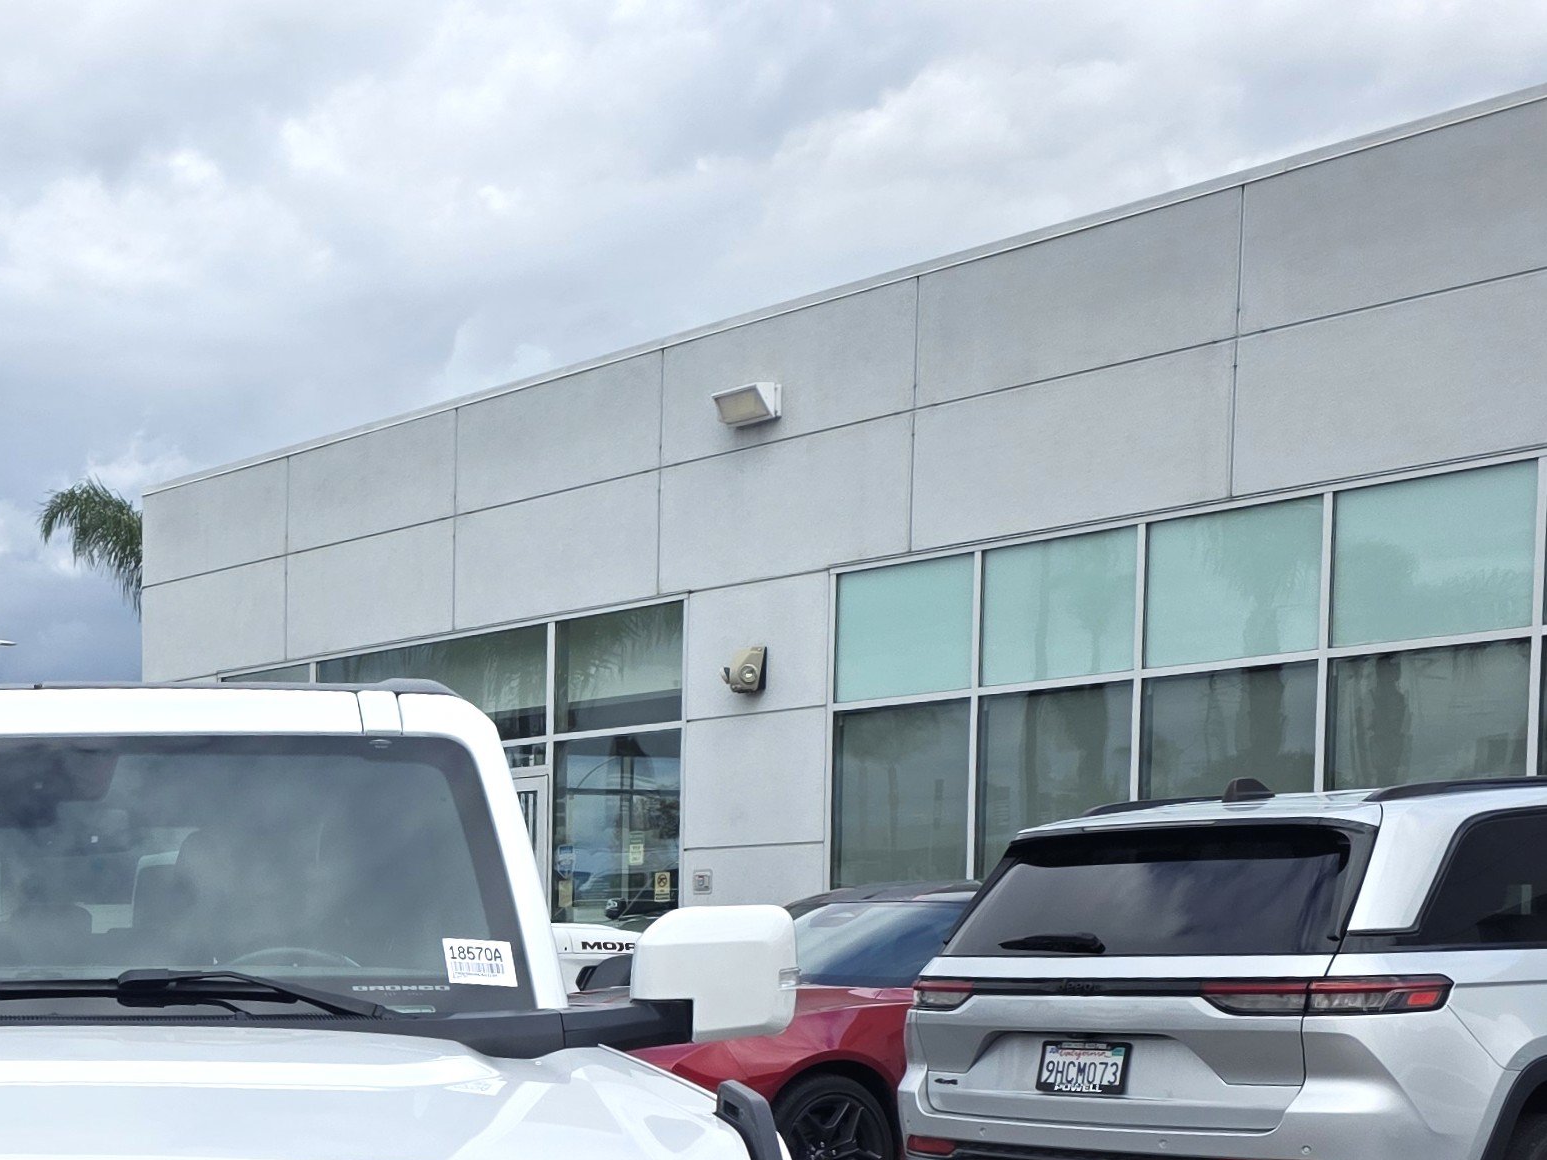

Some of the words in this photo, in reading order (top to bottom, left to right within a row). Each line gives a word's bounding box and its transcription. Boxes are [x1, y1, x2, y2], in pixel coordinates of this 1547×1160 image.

[449, 946, 503, 962] 18570A
[1045, 1060, 1119, 1086] 9HCM073
[1054, 1083, 1103, 1092] POWELL
